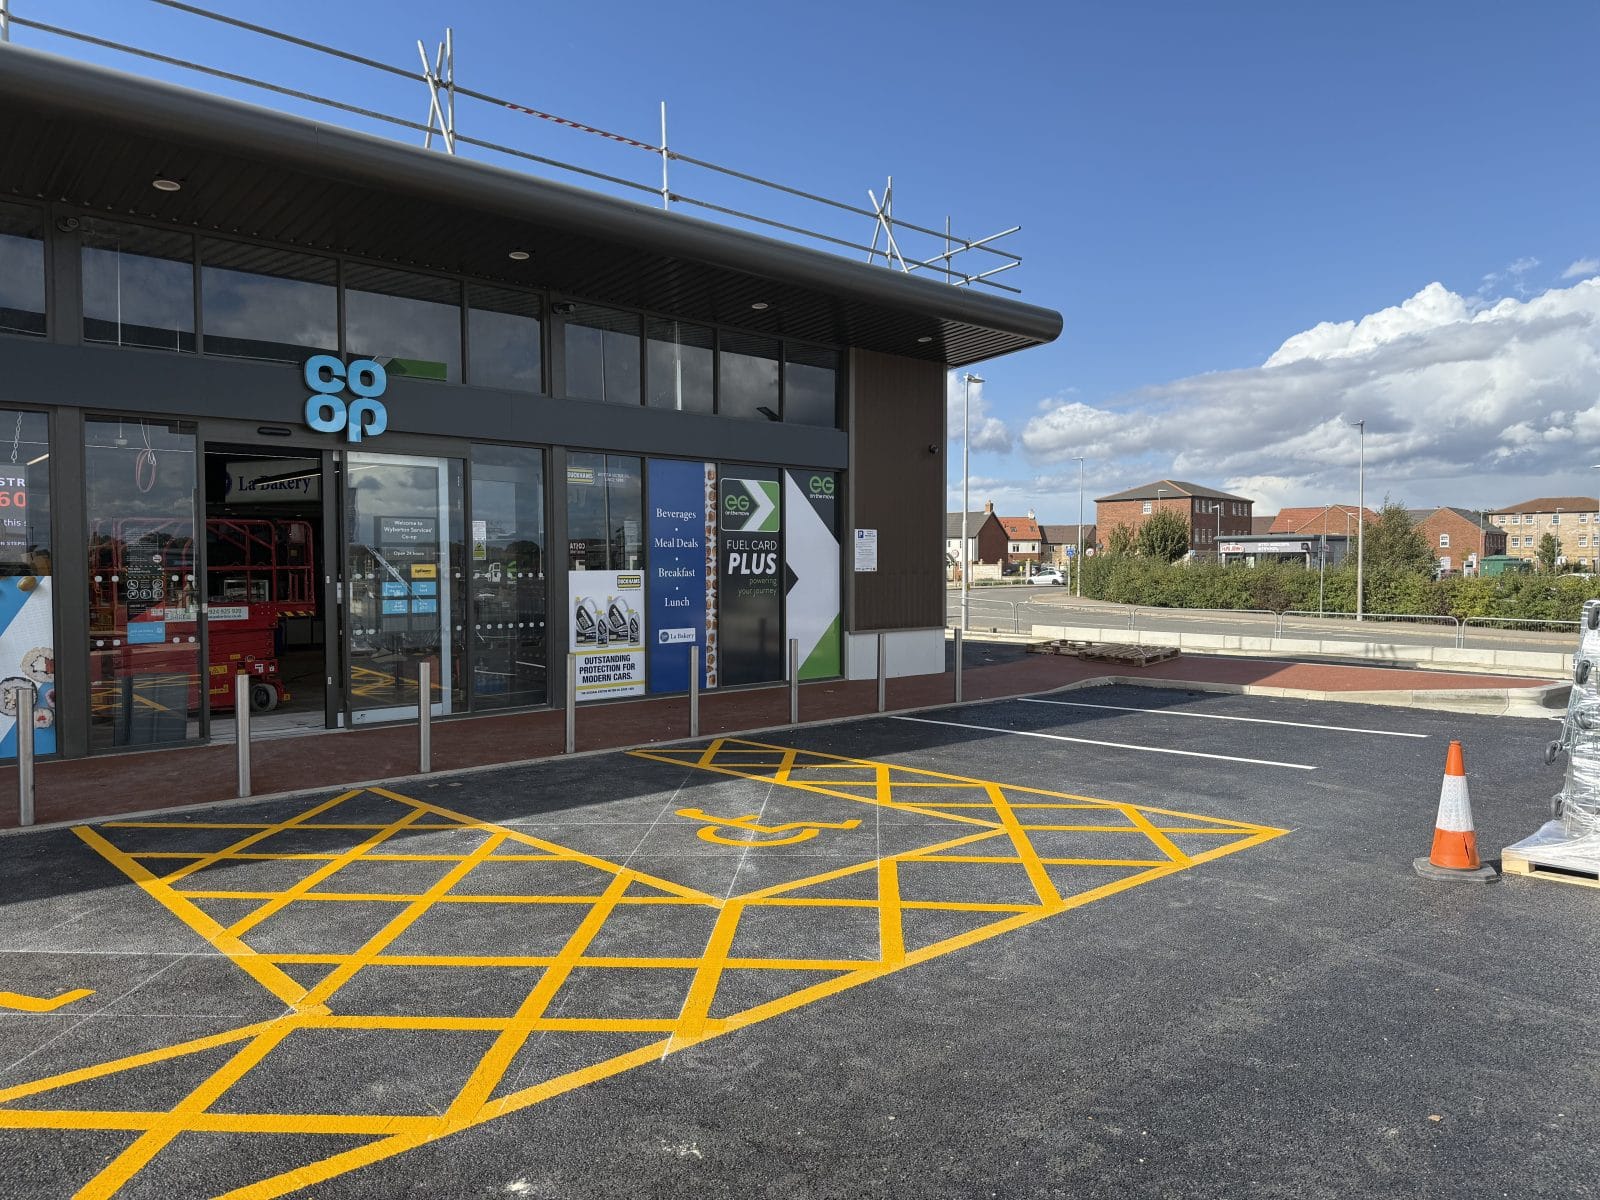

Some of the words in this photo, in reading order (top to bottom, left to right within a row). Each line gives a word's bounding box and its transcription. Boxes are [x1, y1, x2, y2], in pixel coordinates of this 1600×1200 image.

[238, 476, 256, 491] La
[656, 508, 696, 521] Beverages
[4, 518, 21, 527] this
[654, 538, 675, 548] Meal
[676, 538, 699, 548] Deals
[726, 540, 749, 550] FUEL
[751, 540, 777, 551] CARD
[728, 553, 777, 575] PLUS
[658, 567, 696, 577] Breakfast
[664, 597, 690, 606] Lunch
[584, 654, 630, 665] OUTSTANDING
[579, 664, 621, 674] PROTECTION
[582, 673, 611, 684] MODERN
[613, 672, 632, 680] CARS.
